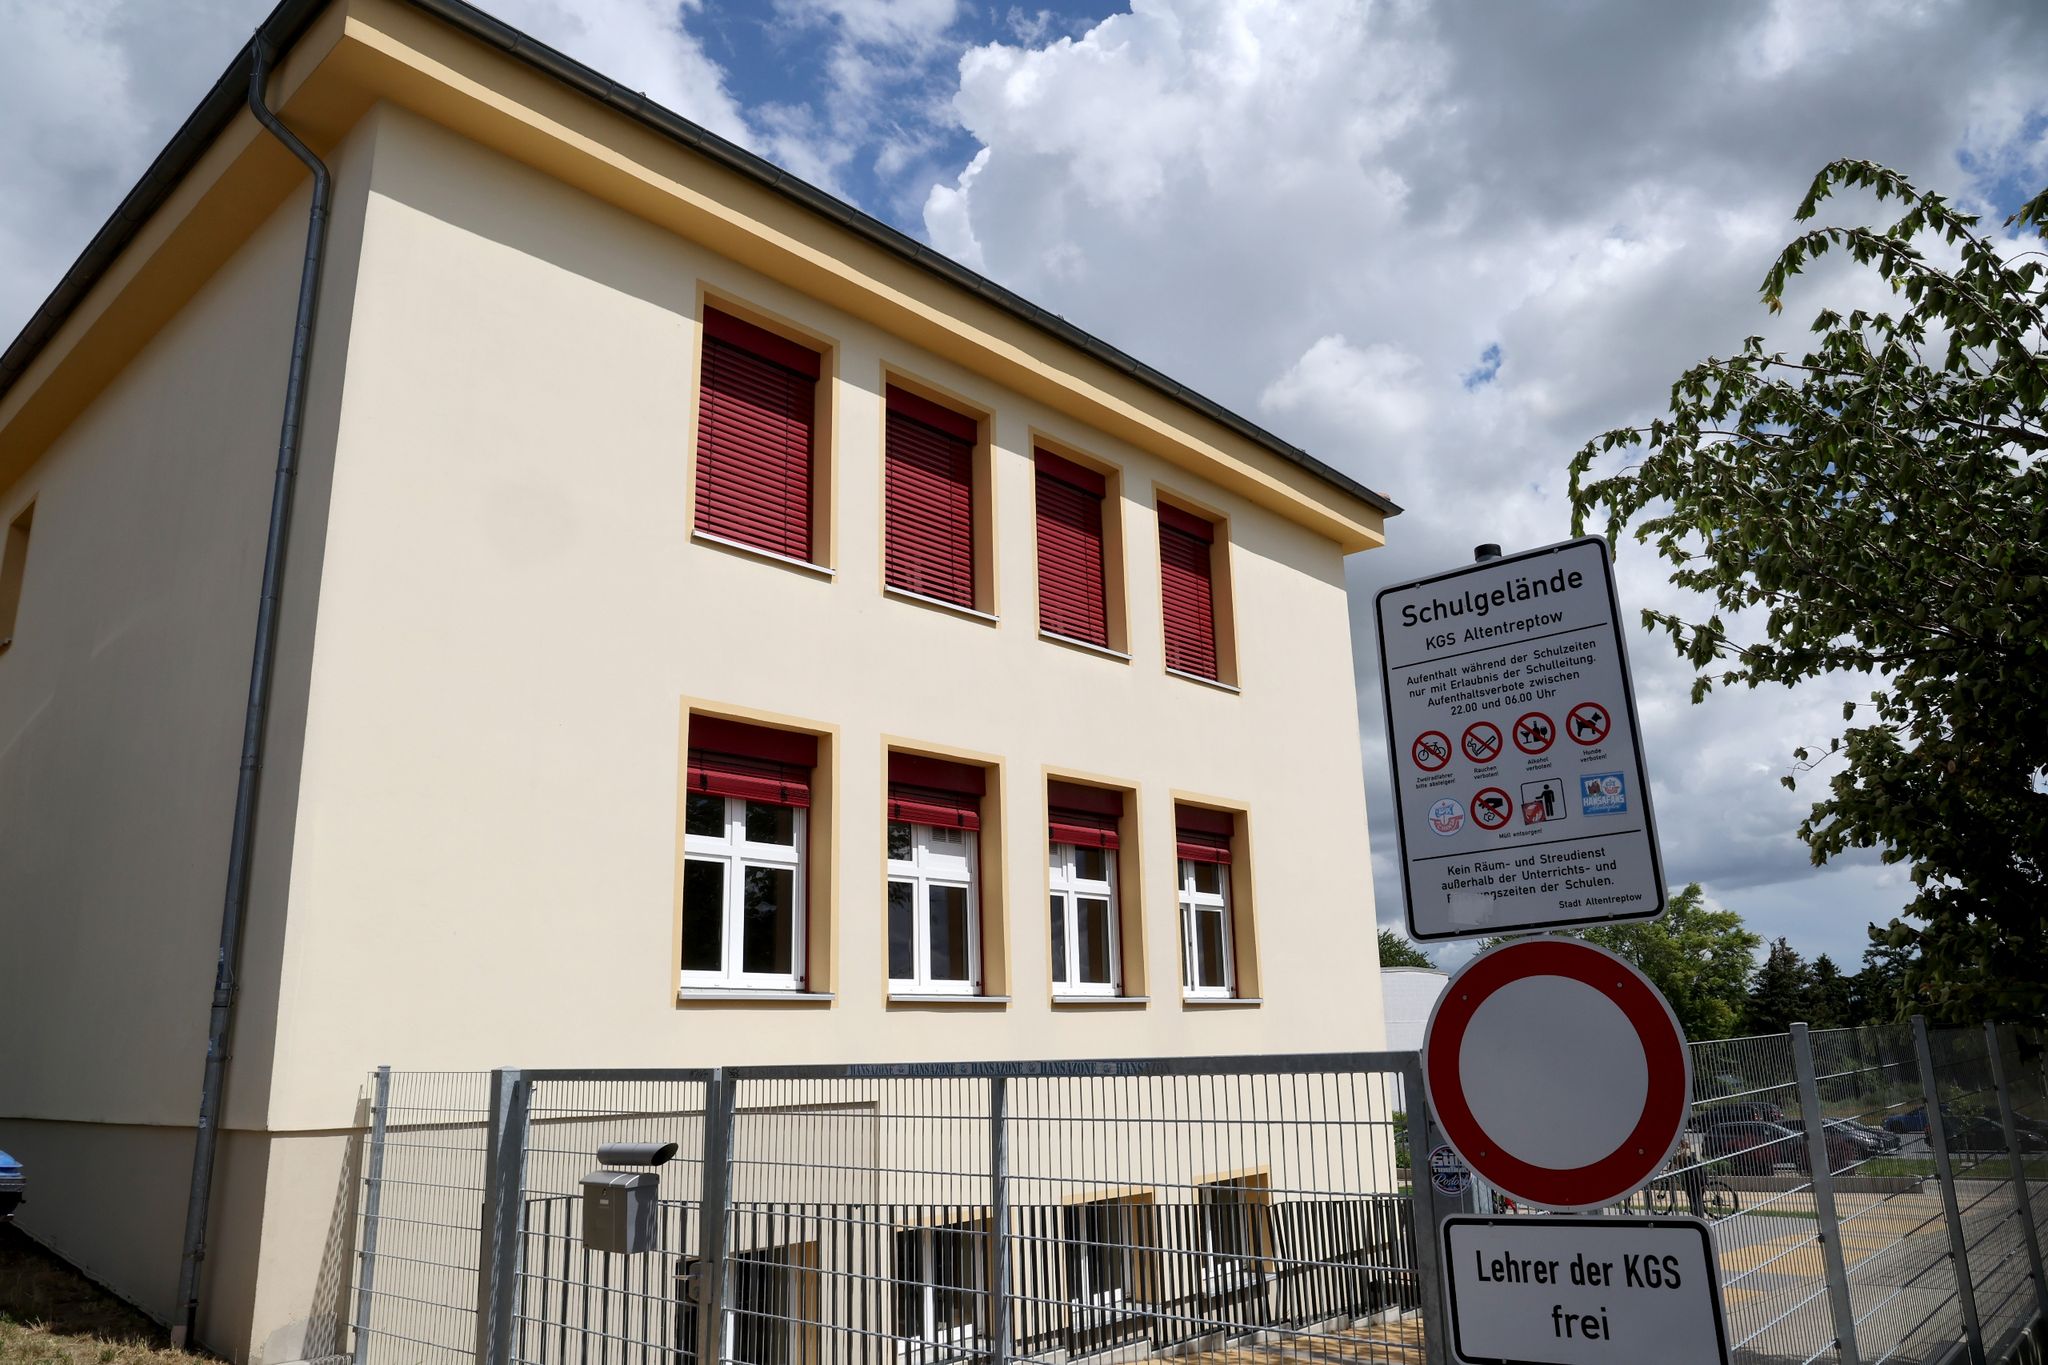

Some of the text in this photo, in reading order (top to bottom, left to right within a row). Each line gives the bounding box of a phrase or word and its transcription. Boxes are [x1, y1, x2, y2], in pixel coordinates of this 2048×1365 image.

[1402, 569, 1583, 626] Schulgelände
[1426, 611, 1563, 650] KGS Altentreptow
[1407, 640, 1596, 686] Aufenthalt während der Schulzeiten
[1409, 654, 1596, 698] nur mit Erlaubnis der Schulleitung.
[1428, 670, 1580, 706] Aufenthaltsverbote zwischen
[1451, 688, 1557, 716] 22.00 und 06.00 Uhr
[1528, 757, 1548, 765] Alkohol
[1580, 754, 1607, 762] verboten!
[1583, 748, 1601, 756] Hunde
[1474, 765, 1496, 773] Rauchen
[1474, 771, 1499, 780] verboten!
[1525, 762, 1552, 771] verboten!
[1417, 772, 1453, 783] Zweiradfahrer
[1499, 831, 1511, 839] Müll
[1447, 848, 1605, 875] Kein Räum- und Streudienst
[1441, 860, 1617, 890] außerhalb der Unterrichts- und
[1541, 882, 1559, 892] der
[1565, 876, 1614, 890] Schulen.
[1559, 893, 1642, 909] Stadt Altentreptow
[1476, 1250, 1681, 1289] Lehrer der KGS
[1552, 1305, 1610, 1340] frei
